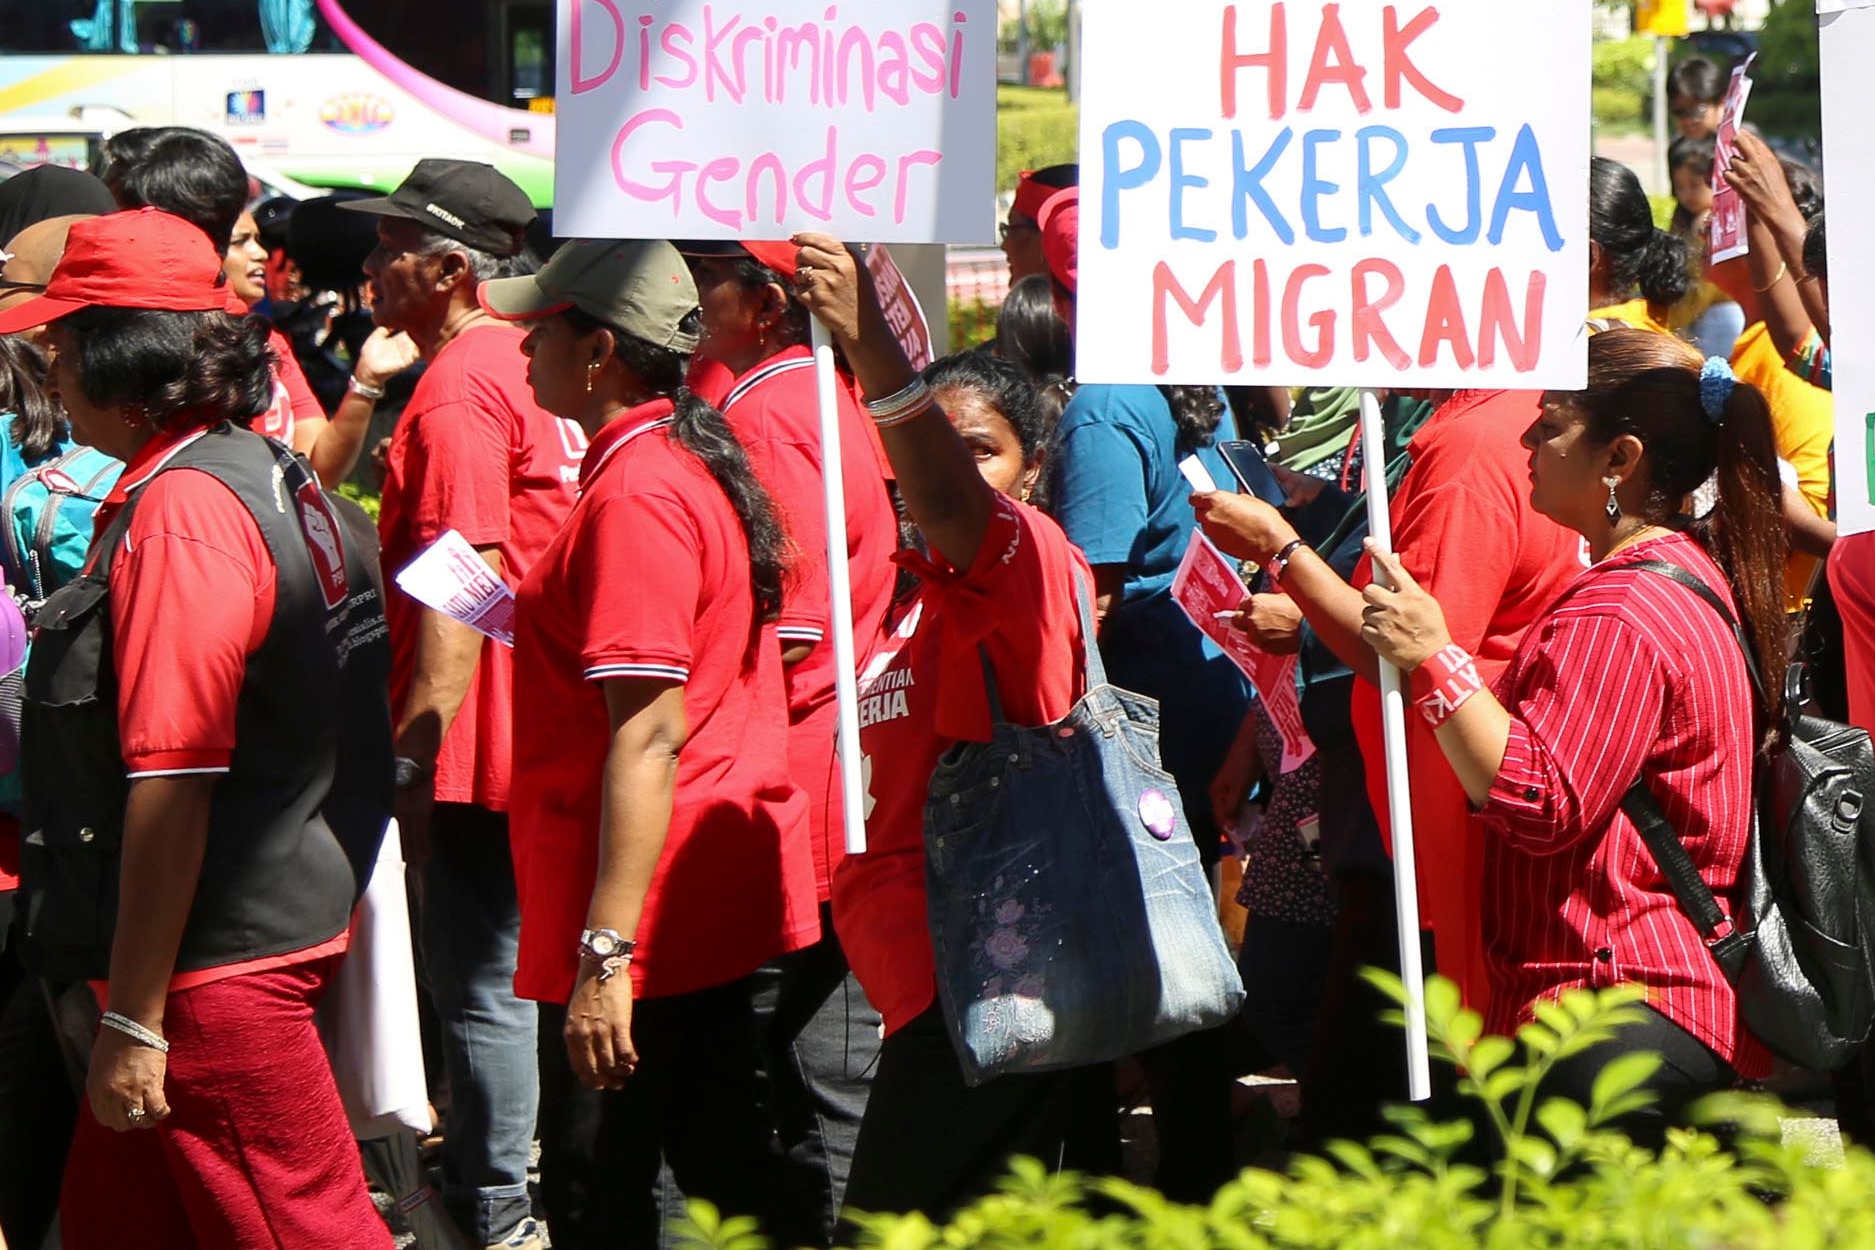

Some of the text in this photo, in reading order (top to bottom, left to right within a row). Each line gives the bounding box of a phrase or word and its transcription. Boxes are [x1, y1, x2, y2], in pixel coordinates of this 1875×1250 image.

[1220, 1, 1465, 120] HAK
[610, 108, 944, 231] Gender
[1100, 120, 1565, 252] PEKERJA
[1151, 258, 1546, 376] MIGRAN
[857, 690, 909, 729] ERJA
